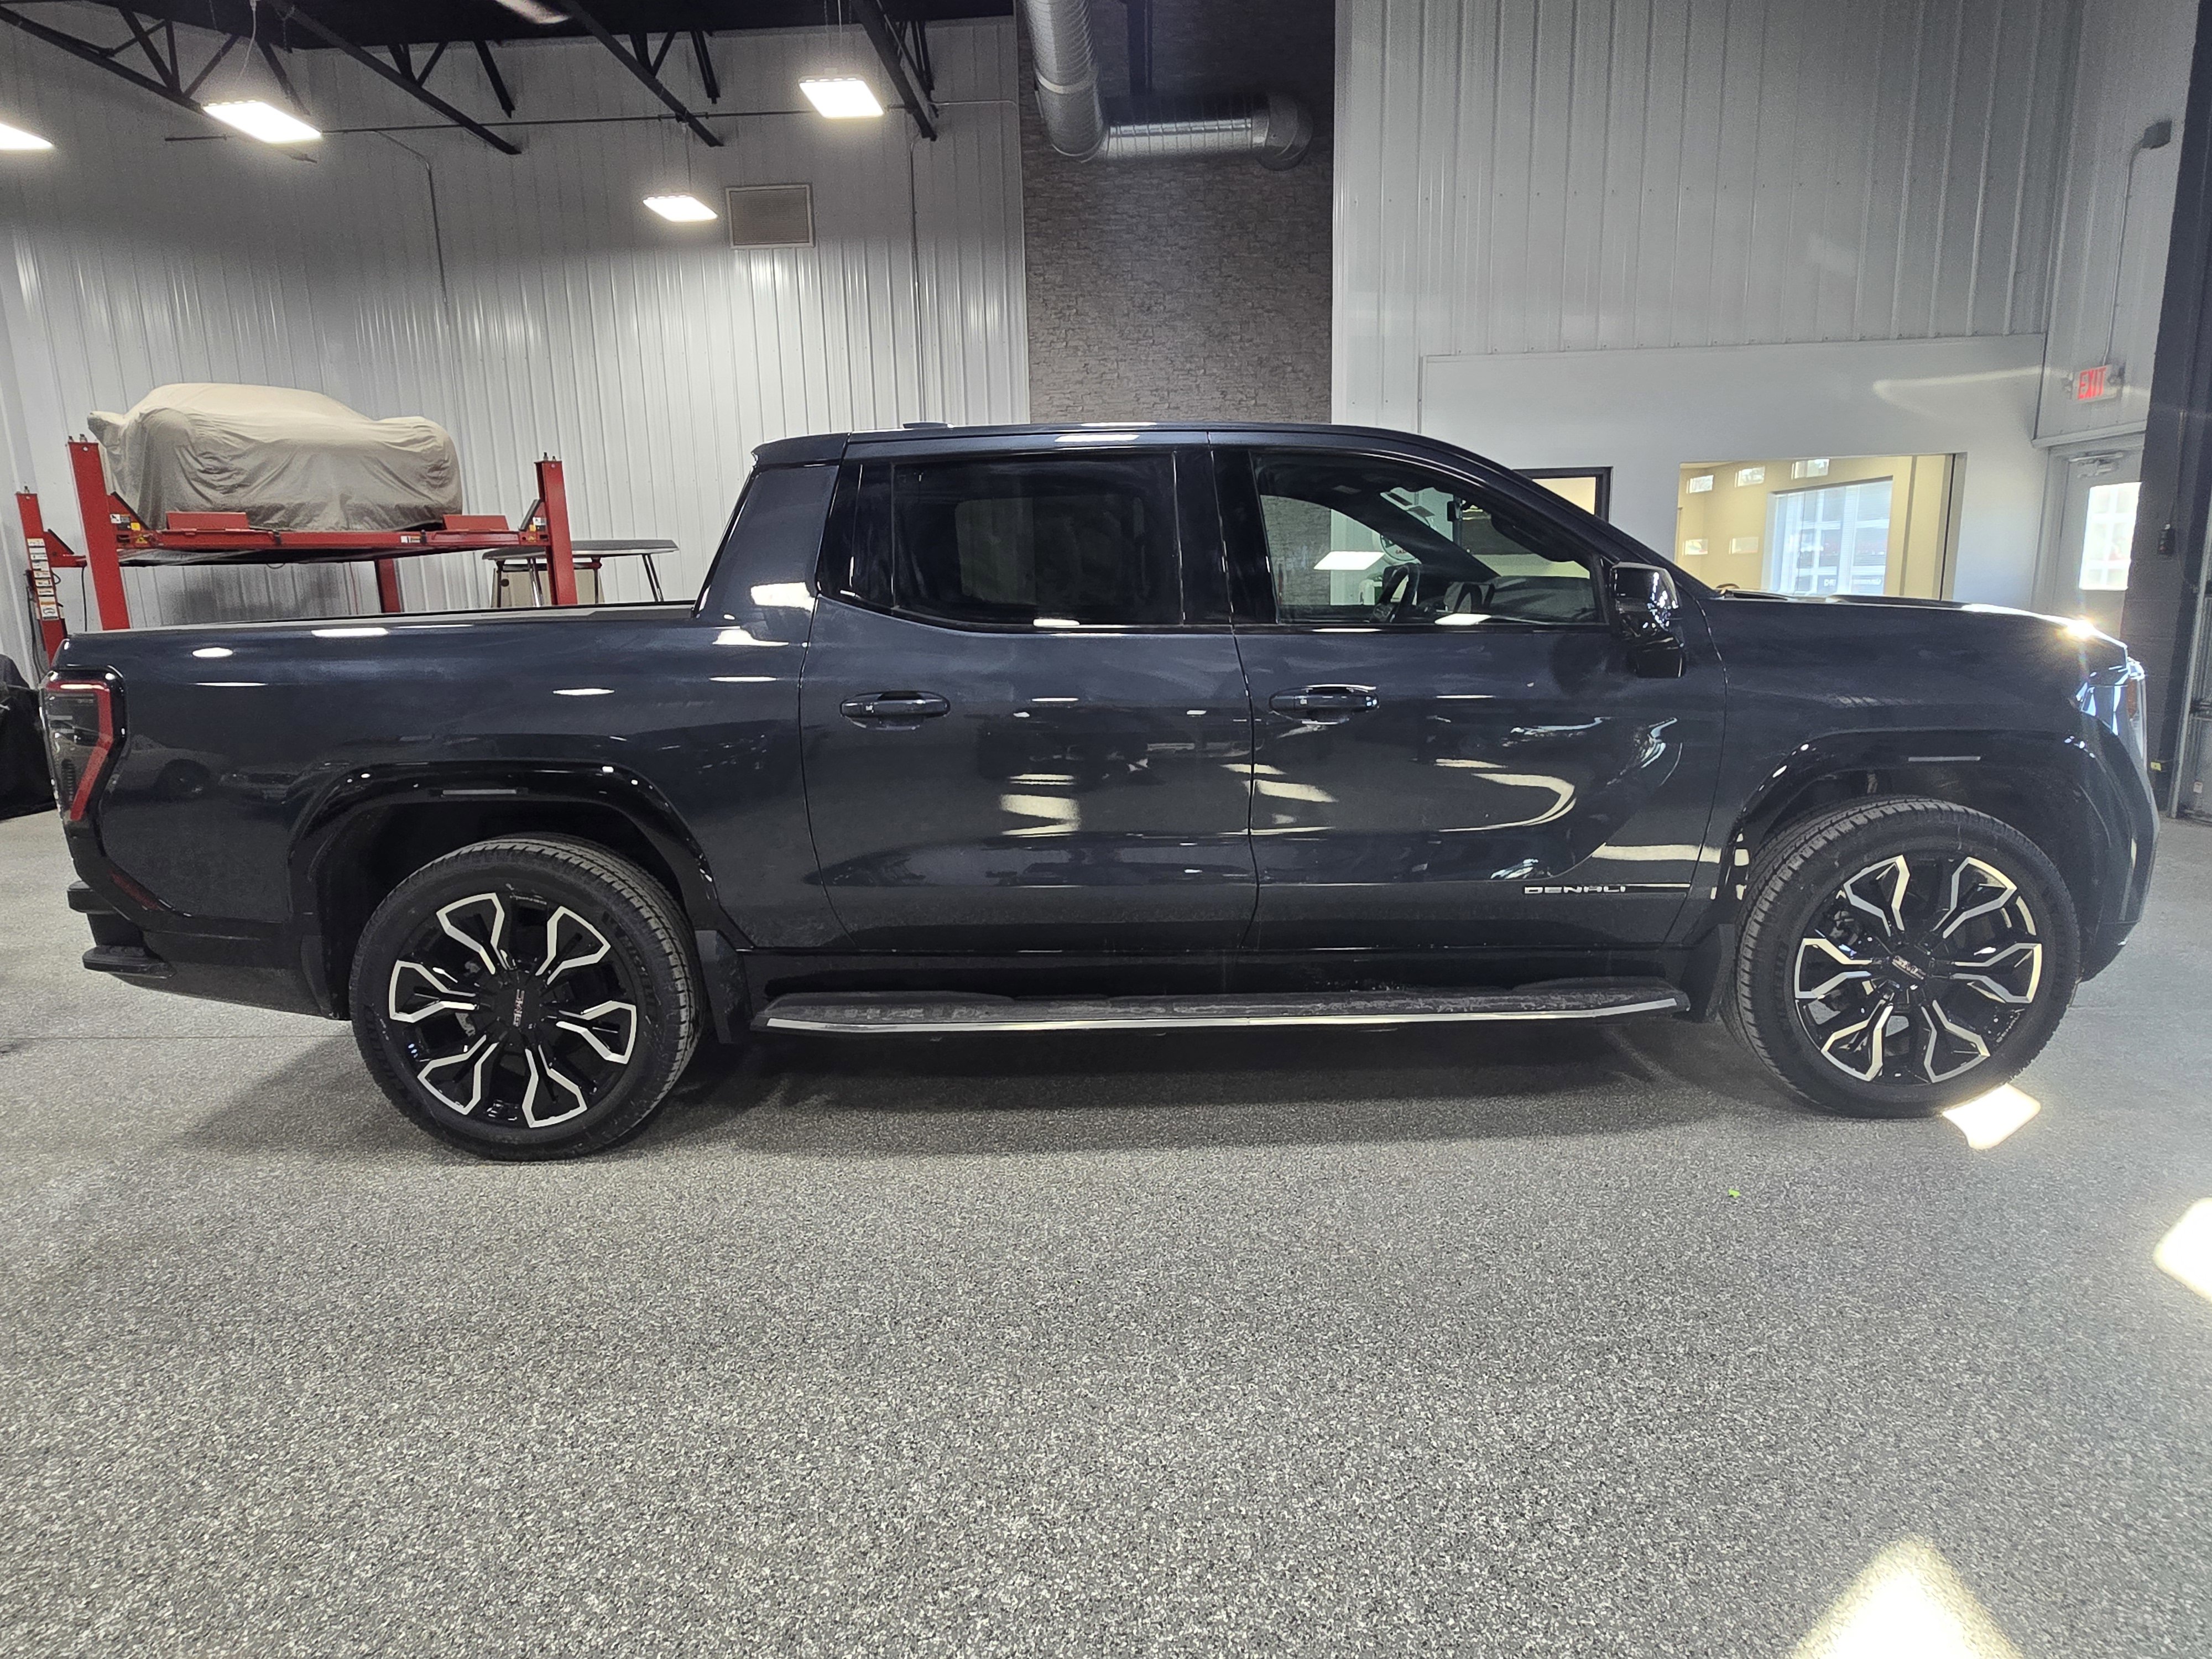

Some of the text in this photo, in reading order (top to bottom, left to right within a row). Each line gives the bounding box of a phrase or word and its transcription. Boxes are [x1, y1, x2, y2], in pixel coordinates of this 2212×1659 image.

[2078, 366, 2107, 399] EXIT
[1525, 886, 1626, 894] DENALI
[513, 989, 525, 1027] GMC
